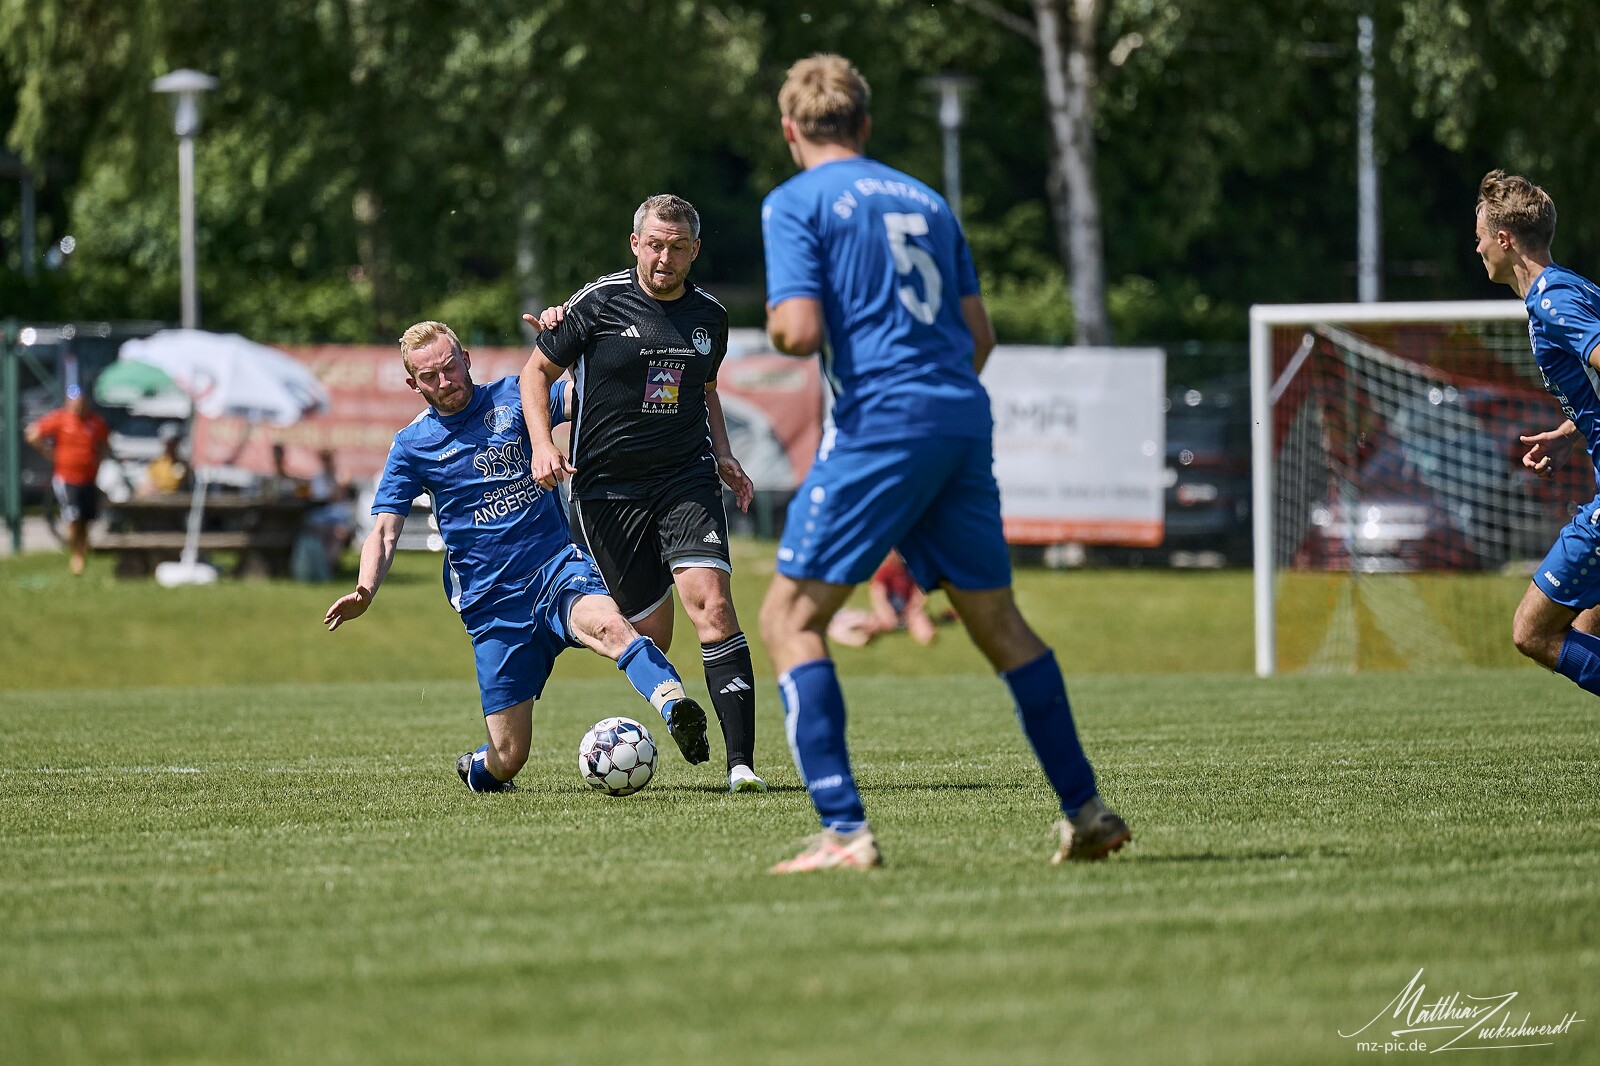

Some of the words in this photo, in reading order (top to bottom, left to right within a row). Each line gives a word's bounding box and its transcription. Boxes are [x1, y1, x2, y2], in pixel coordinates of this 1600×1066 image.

[883, 212, 943, 325] 5
[648, 360, 686, 371] MARKUS
[438, 448, 458, 461] JAKO
[474, 483, 545, 526] ANGERER
